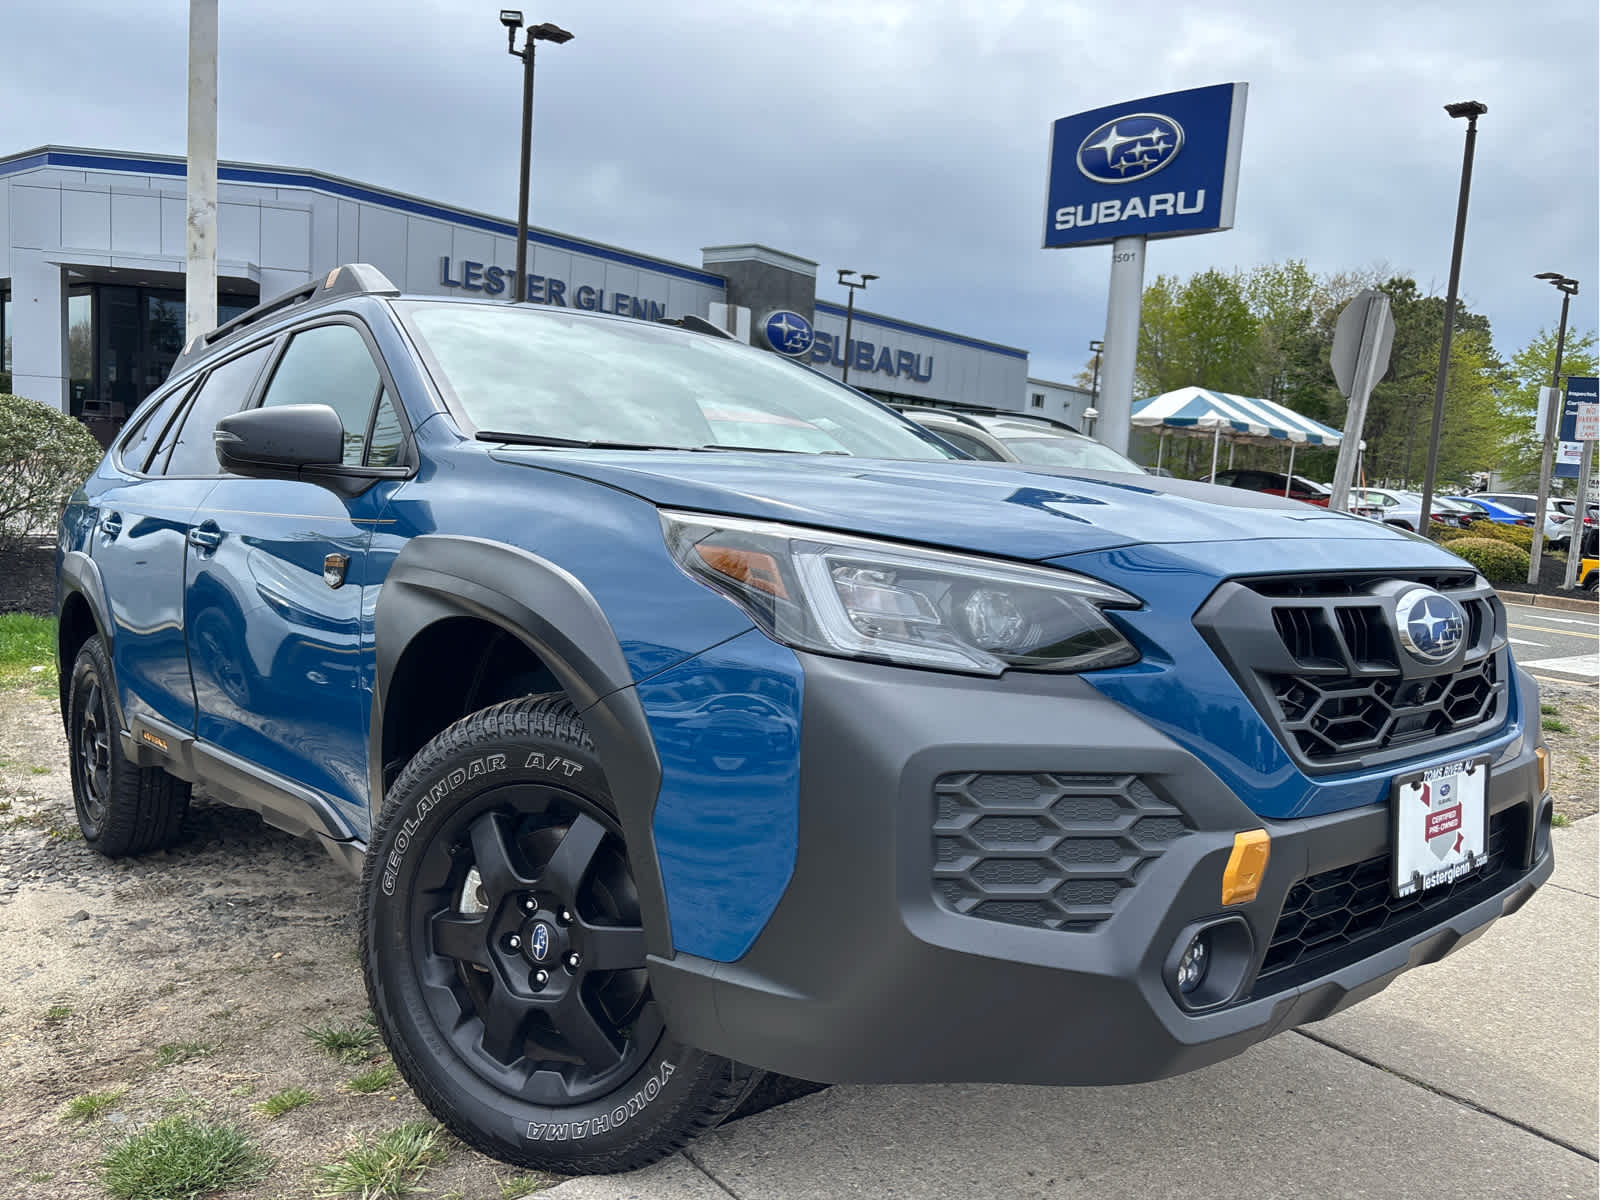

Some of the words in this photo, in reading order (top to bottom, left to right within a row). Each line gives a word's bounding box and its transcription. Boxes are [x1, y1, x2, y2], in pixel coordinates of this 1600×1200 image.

[1055, 189, 1206, 231] SUBARU
[575, 284, 666, 322] GLENN
[810, 330, 934, 383] SUBARU
[1424, 767, 1444, 782] TOMS
[1465, 760, 1474, 771] NJ
[382, 754, 506, 896] GEOLANDAR
[525, 752, 583, 777] A/T
[1429, 819, 1459, 835] PRE-OWNED
[1432, 810, 1457, 825] CERTIFIED
[1423, 862, 1470, 891] lesterglenn
[527, 1059, 676, 1141] YOKOHAMA
